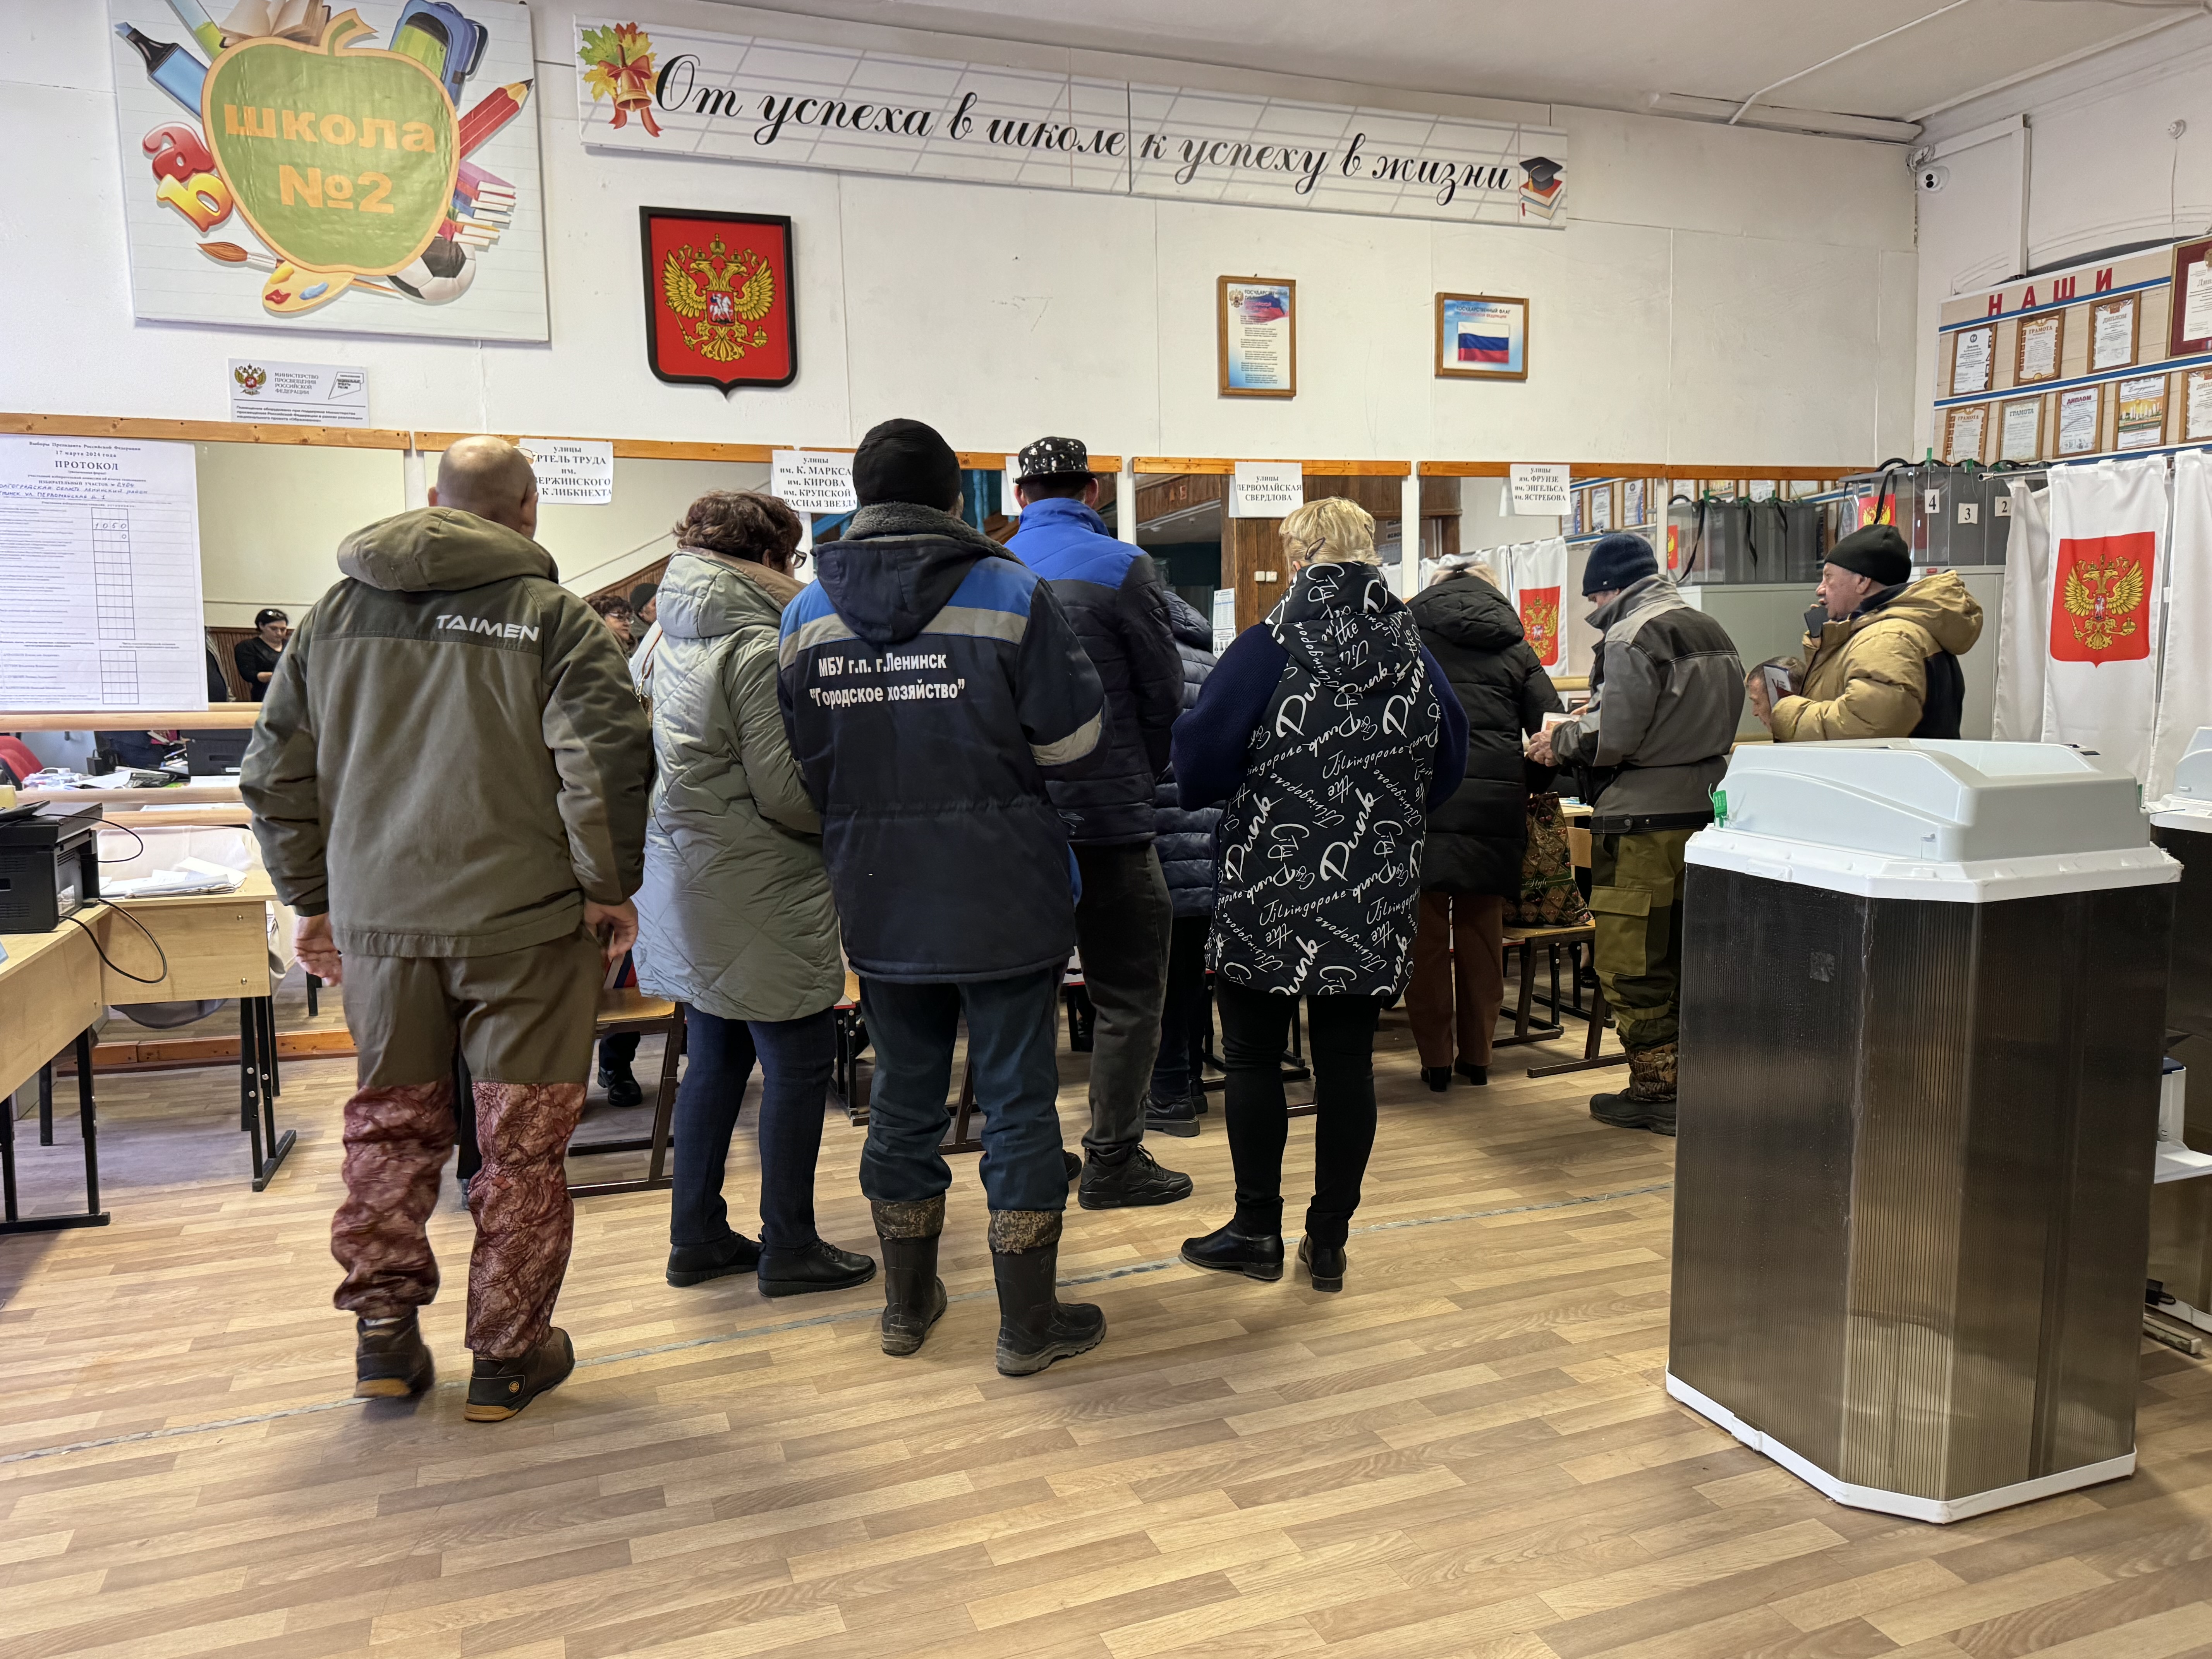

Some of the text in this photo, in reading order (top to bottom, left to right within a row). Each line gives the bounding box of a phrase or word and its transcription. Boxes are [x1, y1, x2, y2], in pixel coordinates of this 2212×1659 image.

[223, 103, 436, 154] школа
[655, 54, 1512, 206] От успеха в школе к успеху в жизни
[279, 164, 395, 215] №2
[1988, 268, 2112, 317] НАШИ
[2029, 326, 2053, 334] ГРАМОТА
[2067, 395, 2092, 405] ДИПЛОМ
[2009, 408, 2034, 417] ГРАМОТА
[537, 455, 606, 465] РТЕЛЬ ТРУДА
[55, 460, 118, 471] ПРОТОКОЛ
[797, 466, 806, 474] К.
[809, 467, 852, 476] МАРКСА
[536, 477, 611, 486] ЕРЖИНСКОГО
[804, 478, 845, 487] КИРОВА
[1237, 483, 1302, 491] ПЕРВОМАЙСКАЯ
[799, 489, 851, 497] КРУПСКОЙ
[785, 499, 821, 507] РАСНАЯ
[1929, 495, 1936, 510] 4
[2002, 501, 2008, 513] 2
[1965, 508, 1971, 520] 3
[436, 615, 539, 642] TAIMEN
[818, 652, 947, 677] МБУ г.п. г.Ленинск
